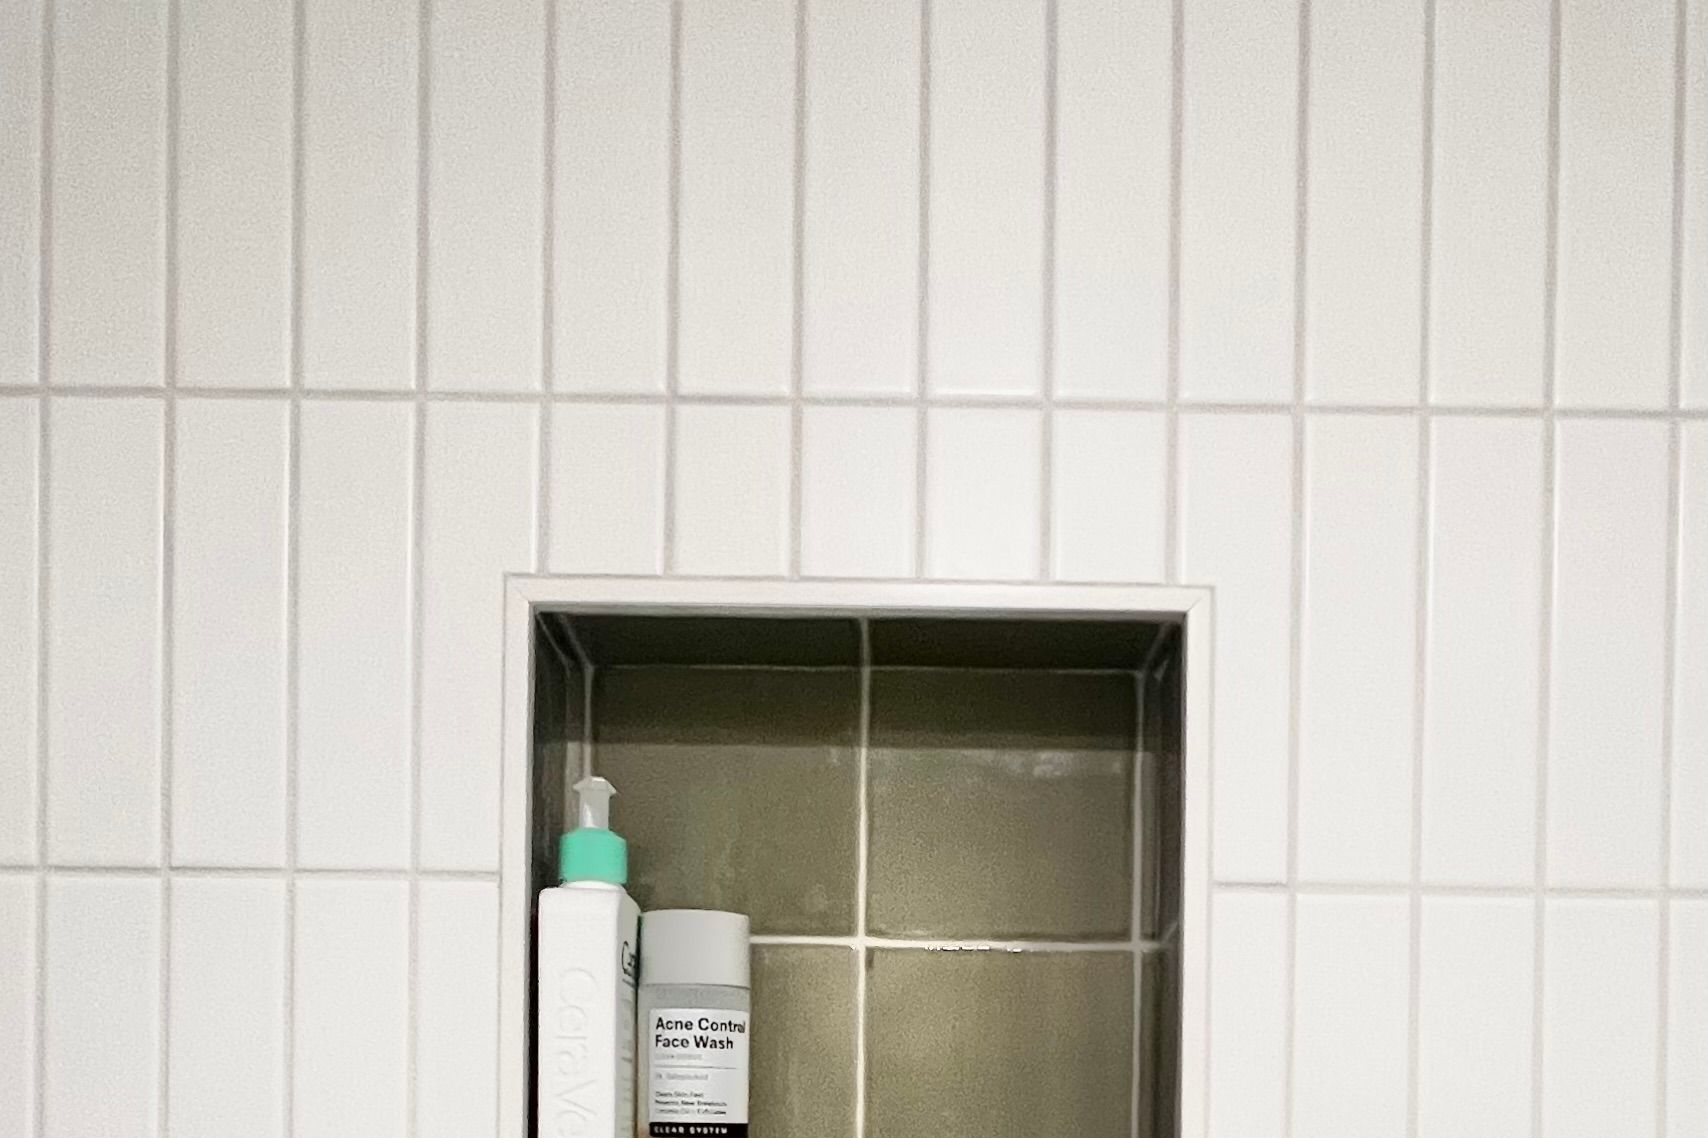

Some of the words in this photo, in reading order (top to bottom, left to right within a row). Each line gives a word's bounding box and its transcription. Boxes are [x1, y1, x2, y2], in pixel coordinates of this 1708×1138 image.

[655, 1016, 694, 1031] Acne
[698, 1017, 746, 1034] Control
[655, 1034, 690, 1048] Face
[693, 1035, 734, 1050] Wash
[554, 966, 600, 1137] CeraVe
[653, 1125, 685, 1134] CLEAR
[689, 1126, 728, 1135] SYSTEM
